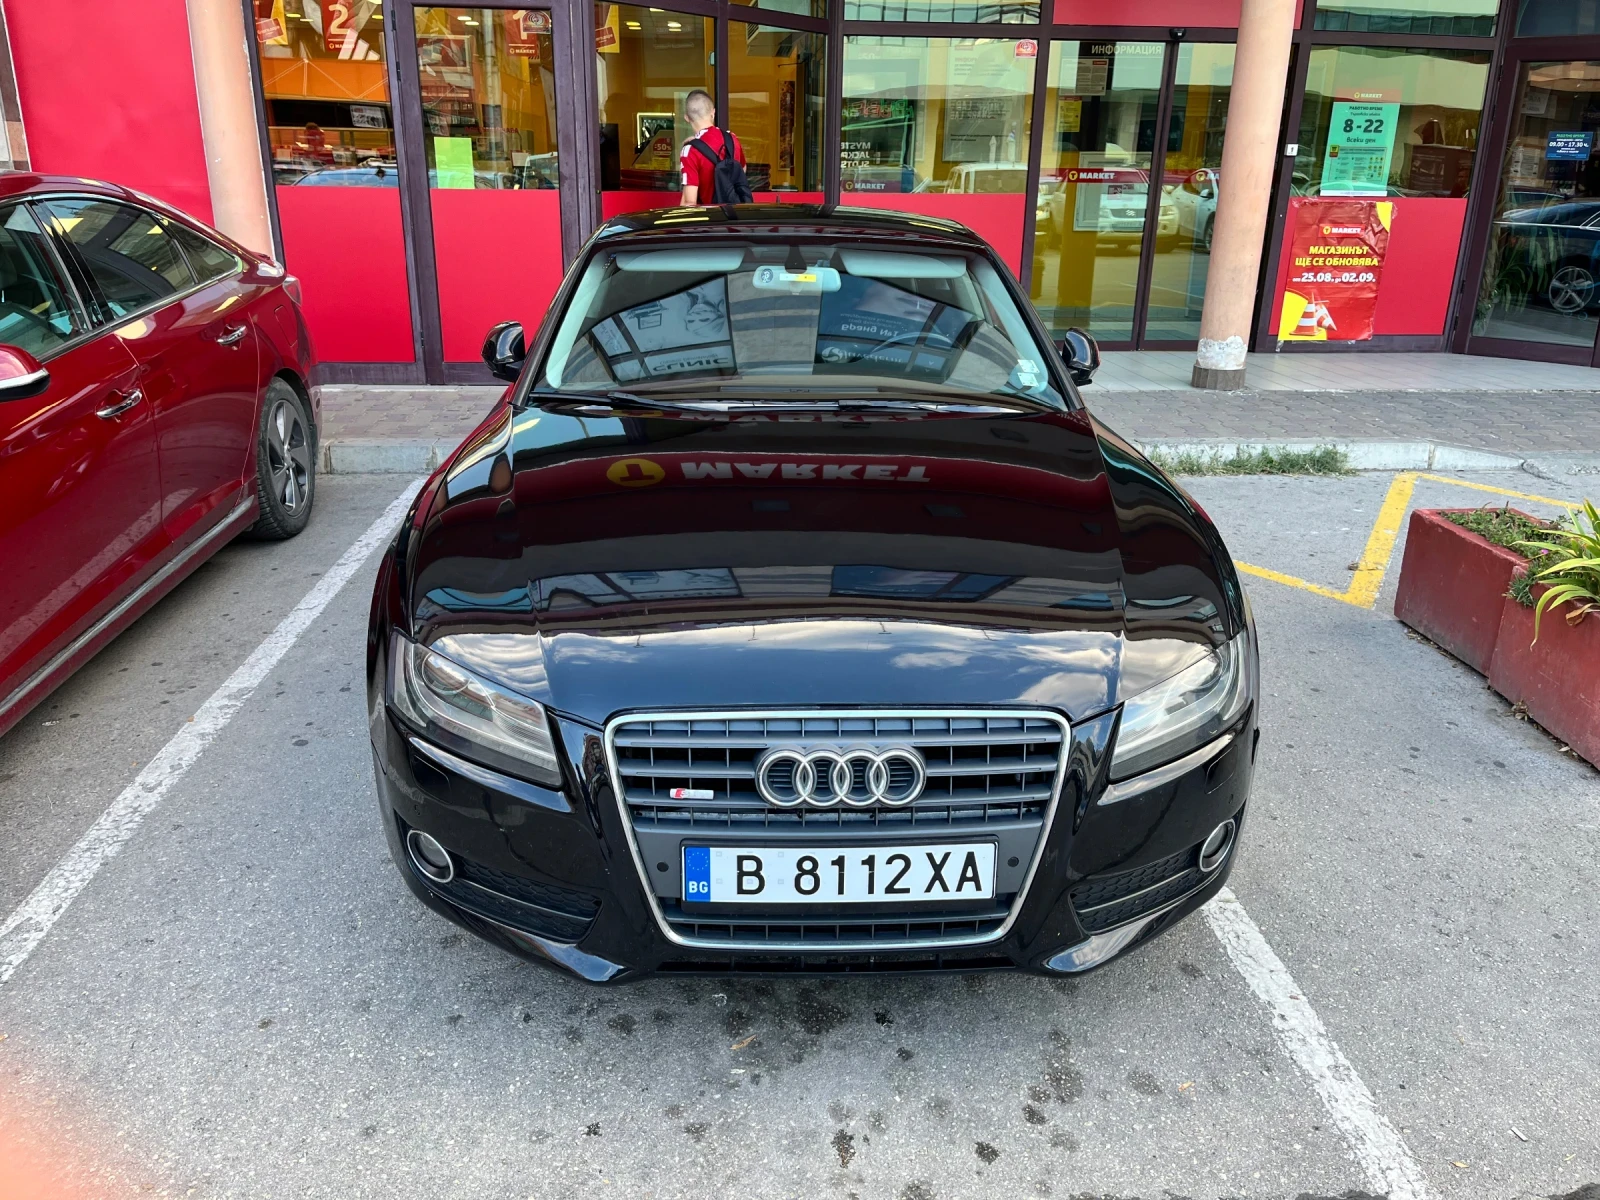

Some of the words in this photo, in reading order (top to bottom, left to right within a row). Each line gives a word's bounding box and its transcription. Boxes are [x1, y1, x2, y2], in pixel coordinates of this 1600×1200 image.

[328, 4, 351, 34] 2
[1091, 45, 1162, 55] ИНФОРМАЦИЯ
[1309, 246, 1369, 254] МАГАЗИНЪТ
[1295, 257, 1311, 267] ЩЕ
[1313, 258, 1324, 266] СЕ
[1325, 258, 1379, 266] ОБНОВЯВА
[1301, 273, 1335, 282] 25.08.
[1342, 273, 1376, 282] 02.09.
[736, 854, 766, 895] B
[794, 853, 912, 895] 8112
[688, 881, 709, 893] BG
